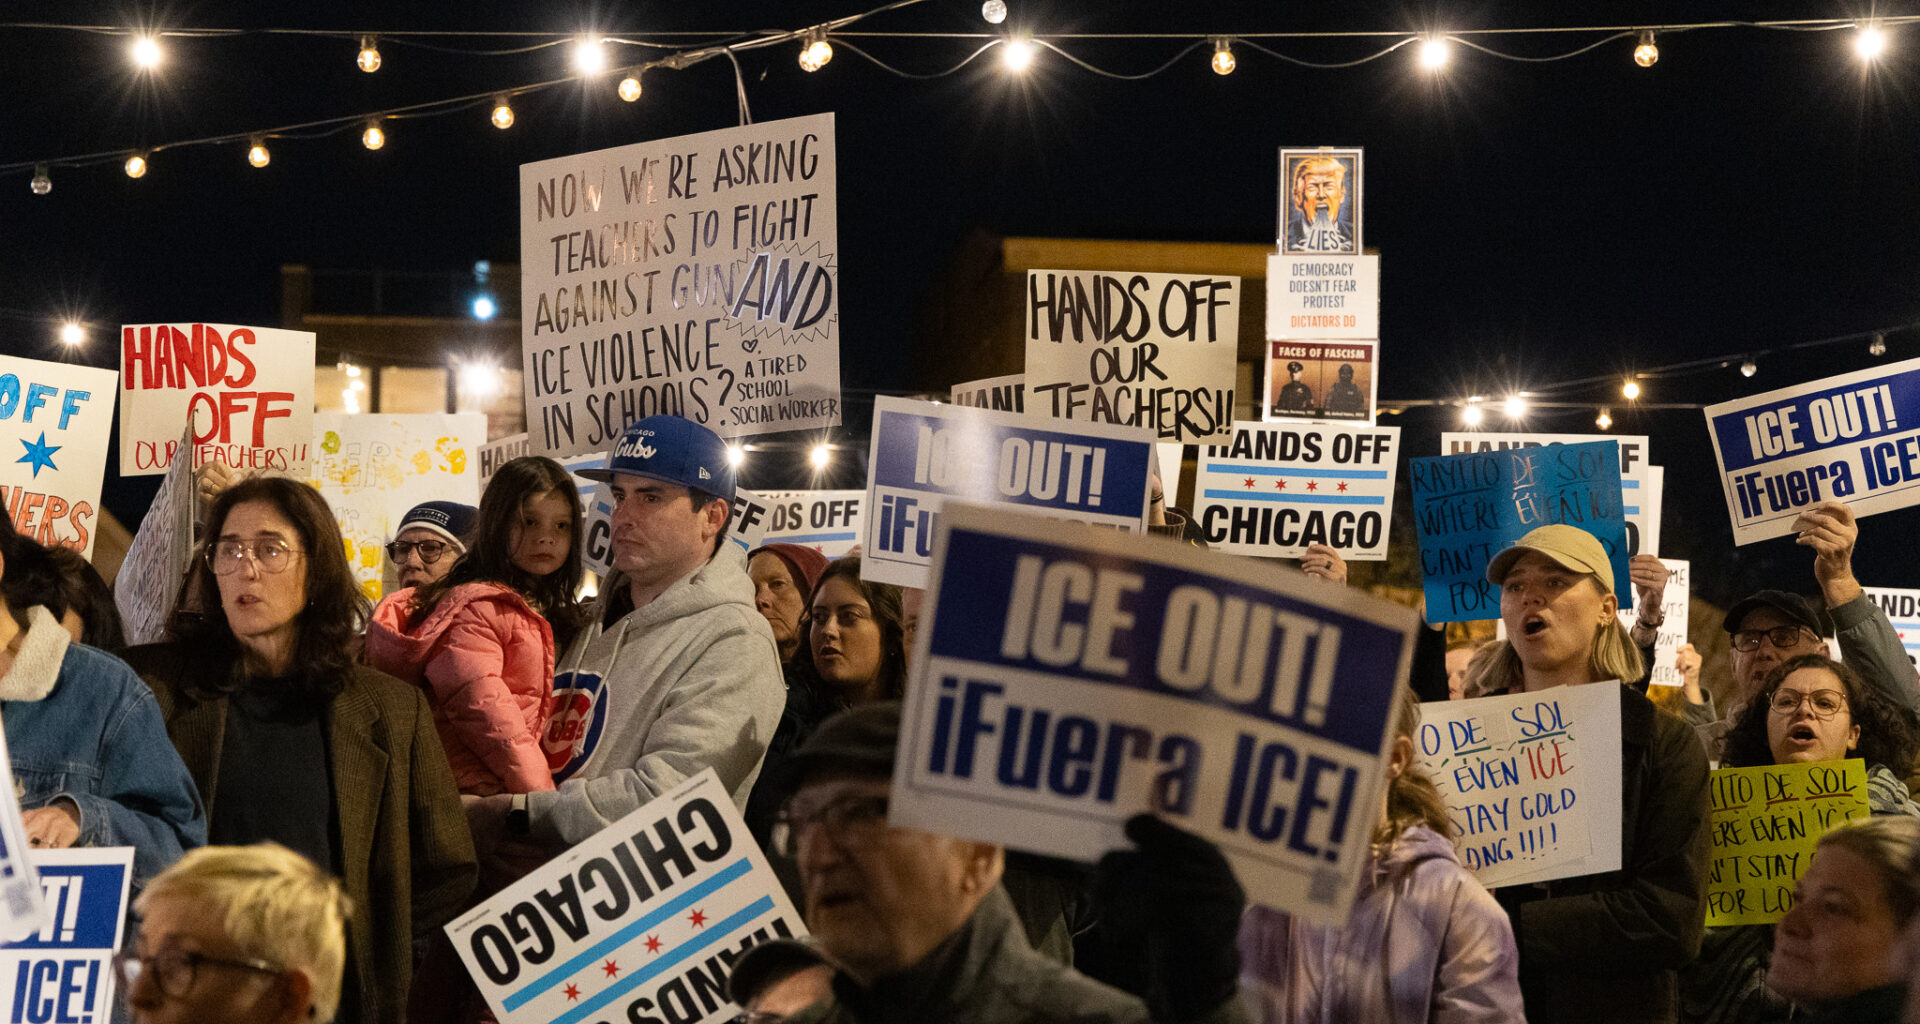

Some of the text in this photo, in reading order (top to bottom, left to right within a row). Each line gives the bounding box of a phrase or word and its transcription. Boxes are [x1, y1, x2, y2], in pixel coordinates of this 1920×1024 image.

[537, 134, 818, 222] NOW WE'RE ASKING
[550, 193, 818, 276] TEACHERS TO FIGHT
[1308, 230, 1340, 251] LIES
[1289, 280, 1357, 293] DOESN'T FEAR
[1292, 263, 1354, 276] DEMOCRACY
[534, 252, 833, 336] AGAINST GUN AND
[1030, 274, 1232, 344] HANDS OFF
[1303, 295, 1345, 308] PROTEST
[1291, 315, 1357, 328] DICTATORS DO
[123, 323, 257, 390] HANDS
[532, 318, 723, 397] ICE VIOLENCE
[745, 354, 807, 378] A TIRED
[1090, 343, 1168, 385] OUR
[1279, 347, 1366, 360] FACES OF FASCISM
[0, 373, 92, 430] OFF
[542, 368, 735, 450] IN SCHOOLS?
[736, 379, 793, 400] SCHOOL
[186, 391, 295, 448] OFF
[729, 399, 839, 425] SOCIAL WORKER
[1033, 382, 1234, 442] TEACHERS!!
[1745, 384, 1898, 461] ICE OUT!
[194, 443, 308, 472] TEACHERS!!
[614, 436, 658, 460] Cubs
[1332, 433, 1391, 464] OFF
[1001, 437, 1106, 507] OUT!
[1410, 457, 1500, 493] RAYITO
[1511, 453, 1539, 485] DE
[1734, 436, 1920, 519] ¡Fuera ICE
[810, 500, 860, 529] OFF
[1202, 504, 1382, 550] CHICAGO
[1420, 543, 1494, 577] CAN'T
[1449, 577, 1500, 616] FOR
[1000, 553, 1343, 728] ICE OUT!
[1448, 717, 1487, 750] DE
[1511, 701, 1573, 737] SOL
[1453, 741, 1575, 793] EVEN ICE
[1763, 772, 1793, 801] DE
[1806, 766, 1858, 795] SOL
[1221, 730, 1360, 864] ICE!
[1750, 811, 1807, 842] EVEN
[1747, 852, 1800, 880] STAY
[470, 798, 733, 986] CHICAGO
[1707, 888, 1754, 918] FOR
[11, 959, 101, 1024] ICE!
